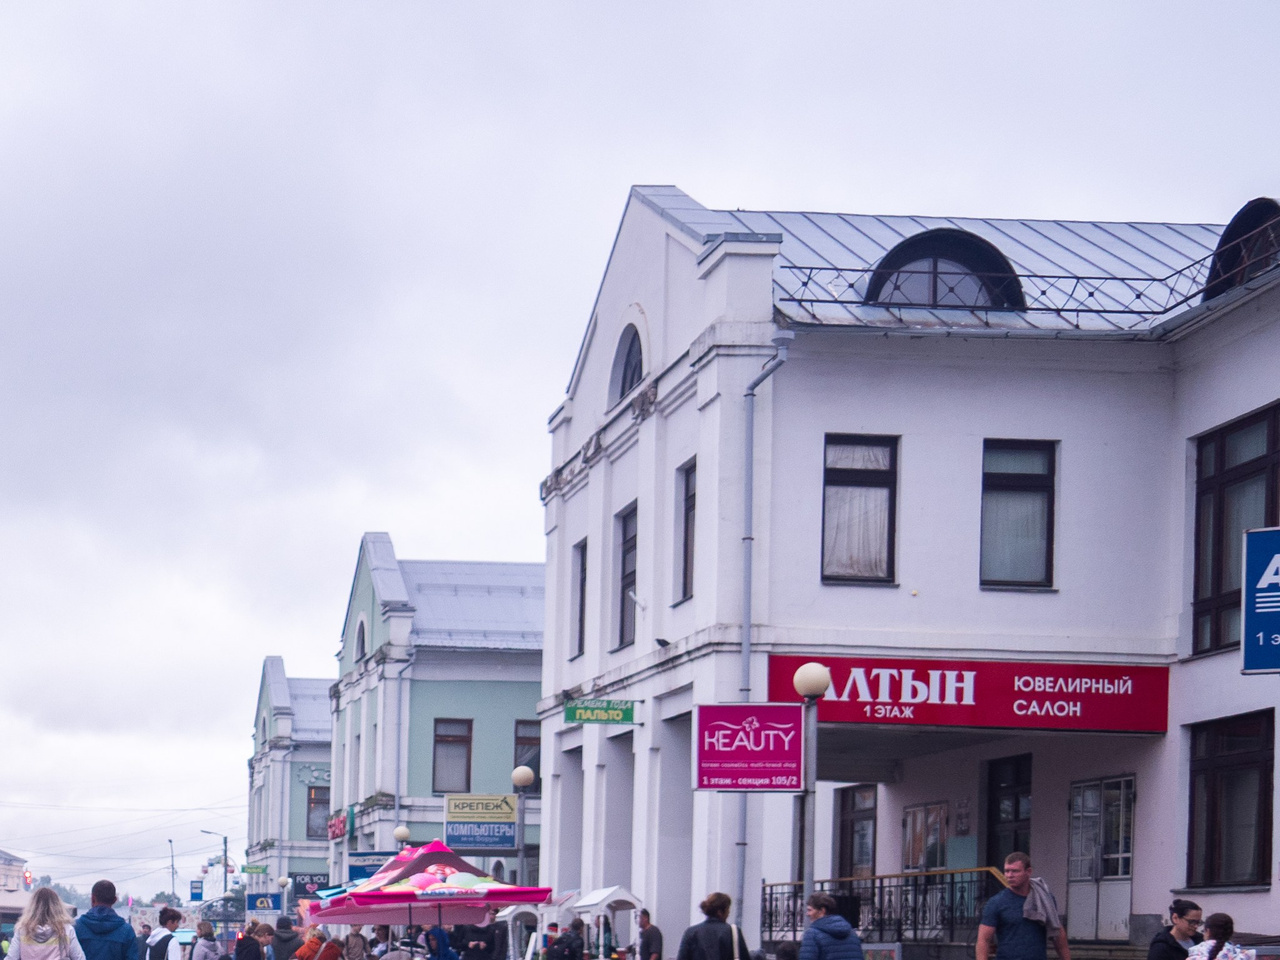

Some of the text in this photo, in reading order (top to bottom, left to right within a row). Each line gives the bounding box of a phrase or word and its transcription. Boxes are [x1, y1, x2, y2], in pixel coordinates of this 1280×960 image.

[1014, 676, 1132, 694] ЮВЕЛИРНЫЙ
[575, 709, 623, 720] ПАЛЬТО
[863, 704, 914, 718] 1 ЭТАЖ
[1013, 700, 1081, 717] САЛОН
[702, 776, 798, 786] 1 этаж секция 105/2
[454, 802, 503, 811] КРЕПЕЖ
[447, 823, 515, 836] КОМПЬЮТЕРЫ
[296, 874, 328, 884] FOR YOU
